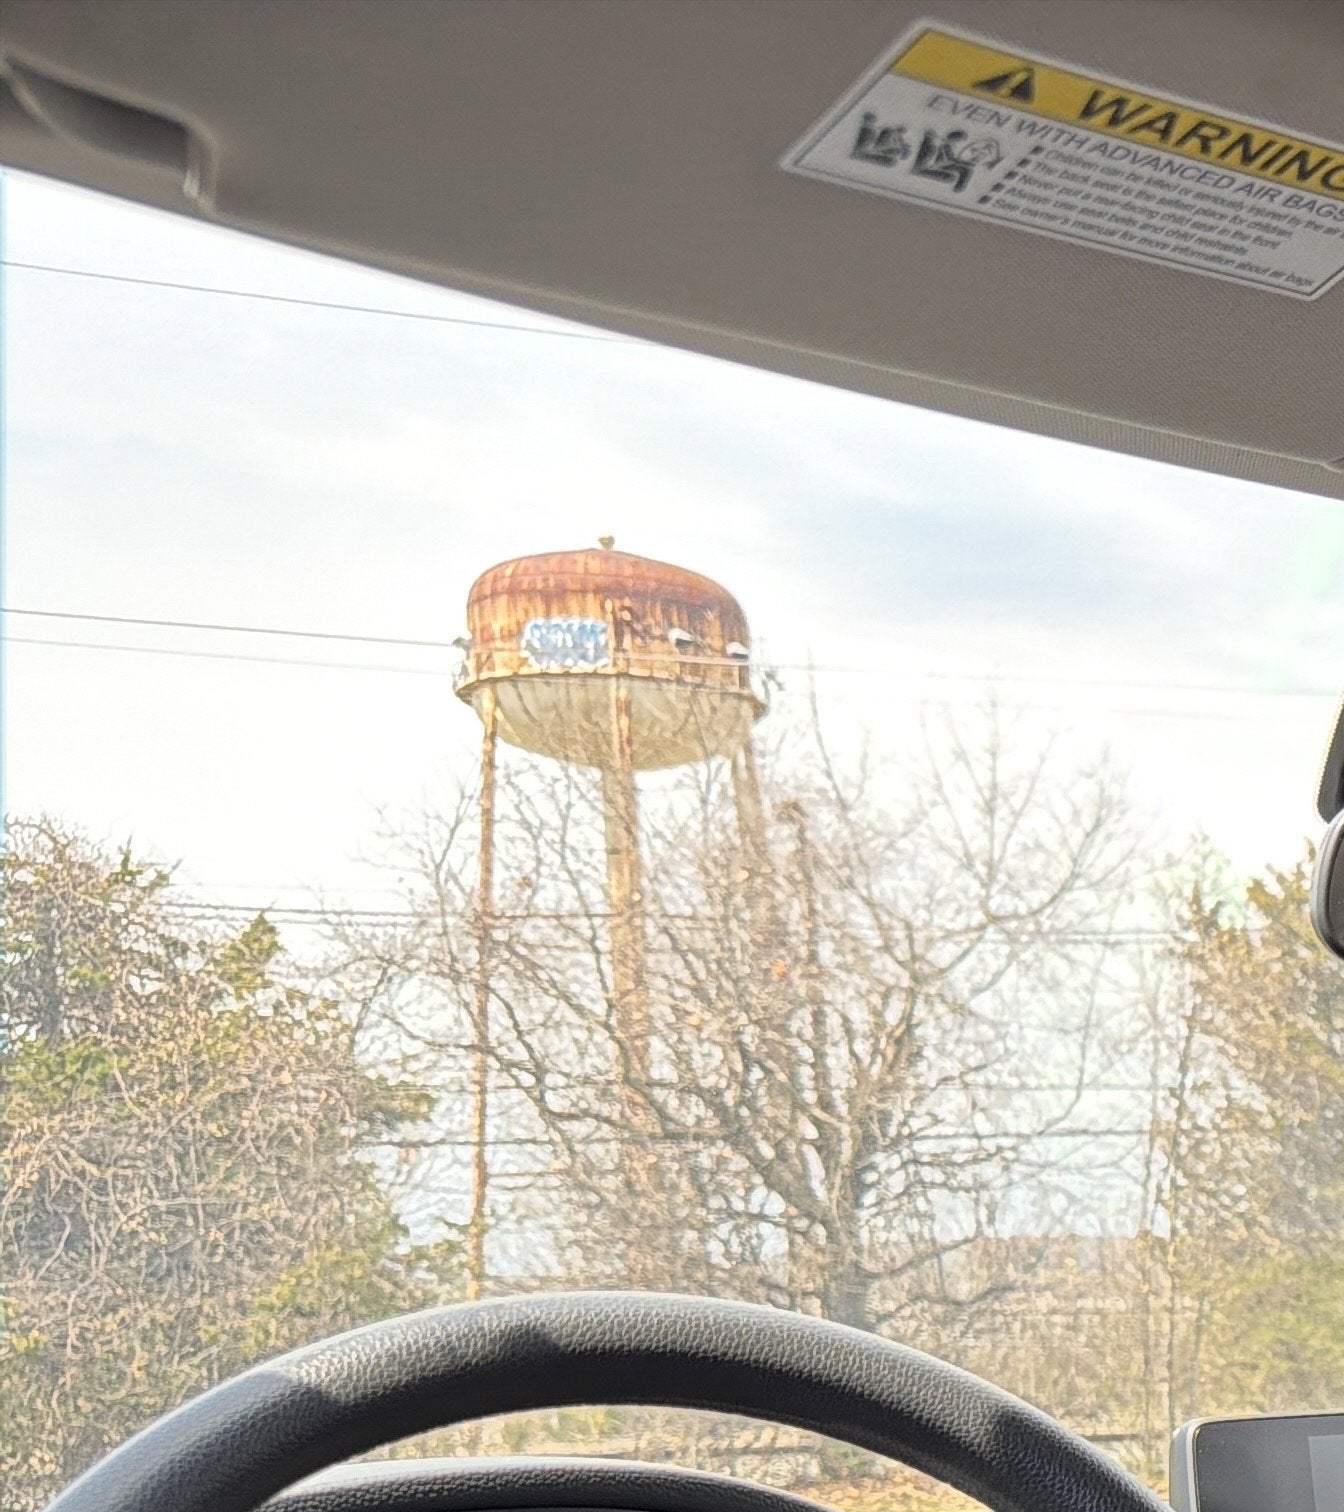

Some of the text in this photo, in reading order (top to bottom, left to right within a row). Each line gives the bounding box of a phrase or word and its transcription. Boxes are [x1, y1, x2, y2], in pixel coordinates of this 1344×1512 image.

[927, 94, 1011, 128] EVEN
[1010, 118, 1092, 149] WITH
[1088, 139, 1239, 190] ADVANCED
[1232, 180, 1285, 202] AIR
